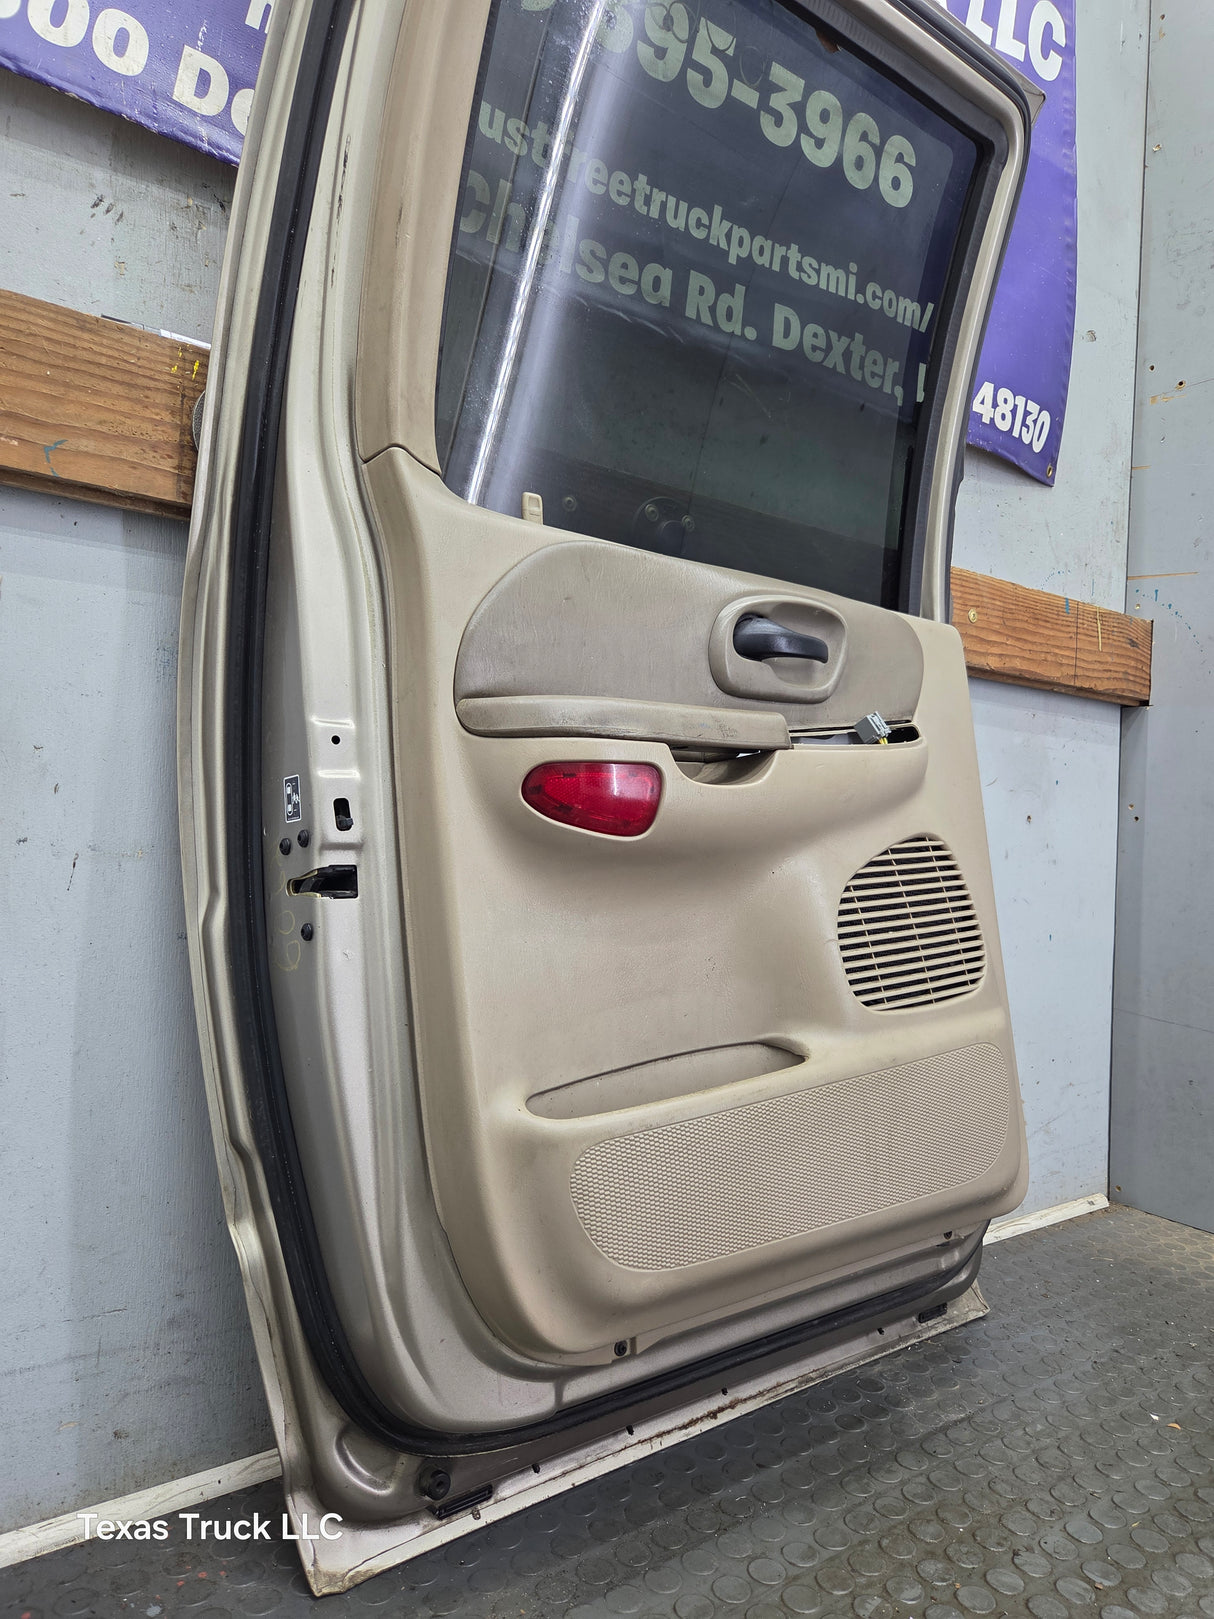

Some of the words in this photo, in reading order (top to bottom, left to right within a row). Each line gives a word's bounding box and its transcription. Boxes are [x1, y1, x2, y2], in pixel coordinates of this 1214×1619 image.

[0, 0, 150, 77] 00
[685, 269, 758, 341] Rd.
[772, 302, 904, 407] Dexter,
[972, 381, 1051, 454] 48130
[478, 100, 935, 334] ustreetruckpartsmi.com/
